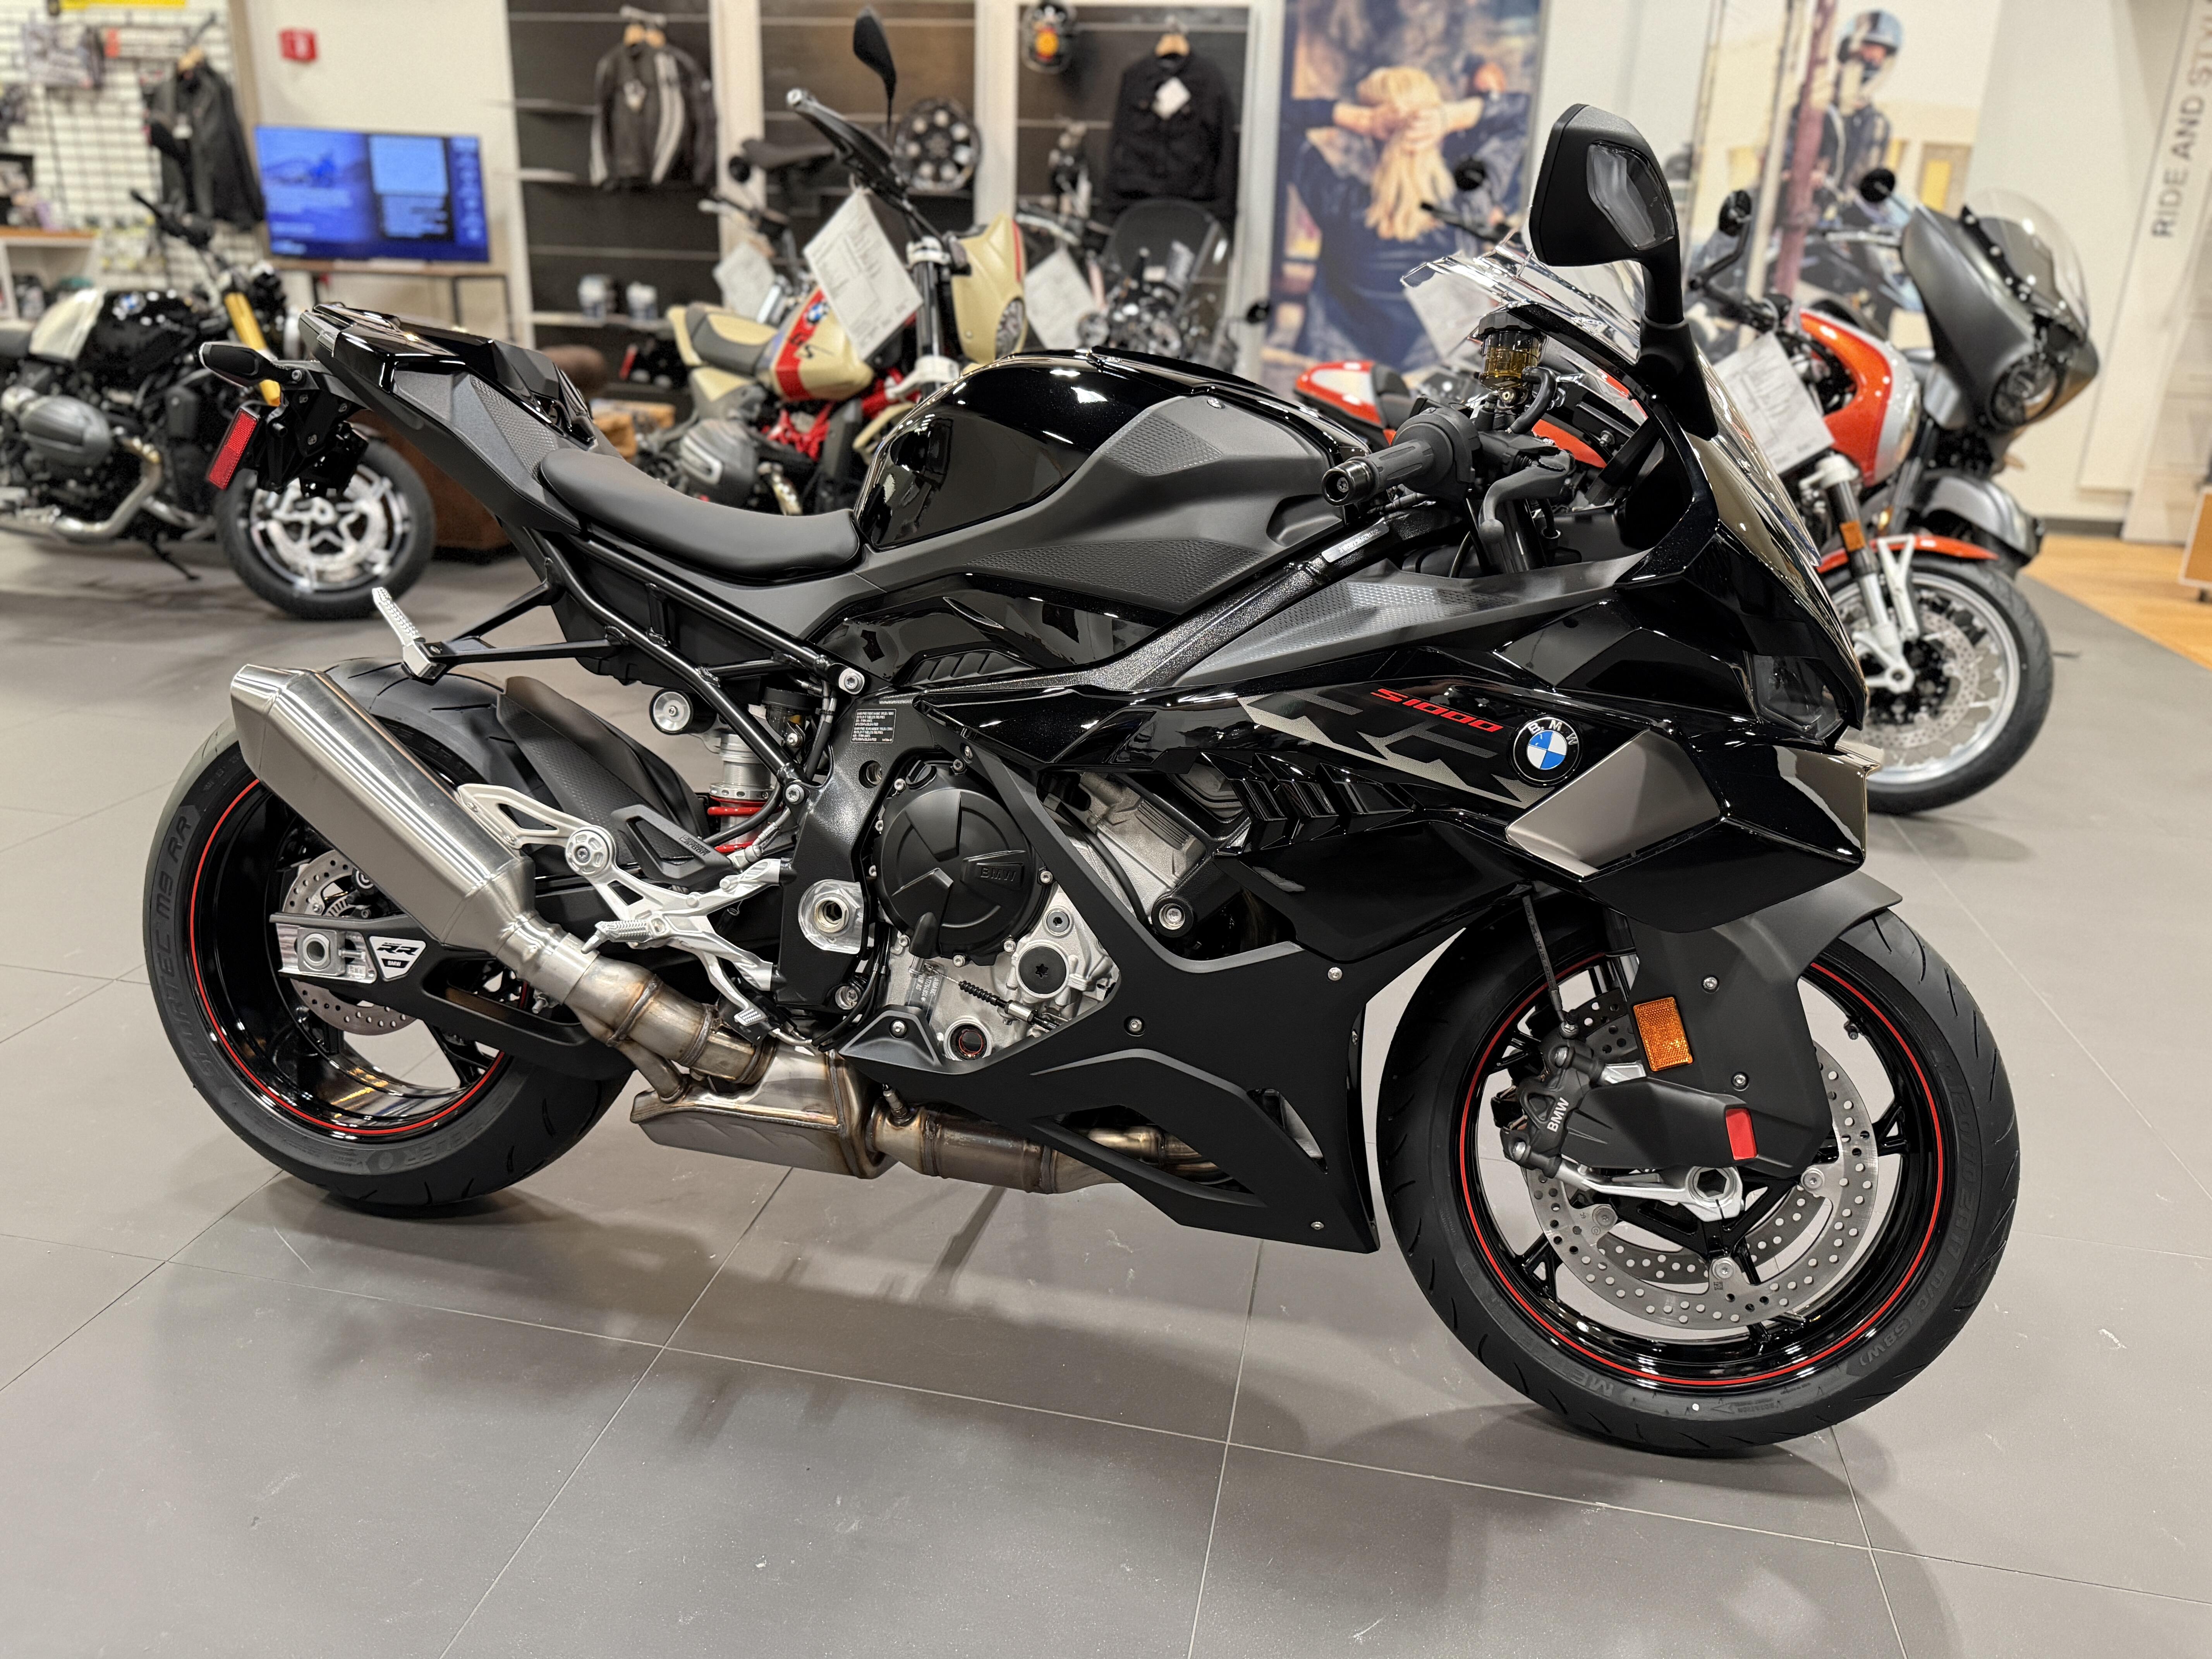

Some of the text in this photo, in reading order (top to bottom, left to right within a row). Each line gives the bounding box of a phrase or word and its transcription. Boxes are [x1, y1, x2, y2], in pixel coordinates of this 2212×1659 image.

[2151, 0, 2212, 238] RIDE AND STY
[1370, 688, 1504, 732] S1000
[1527, 719, 1578, 746] BMW
[156, 871, 173, 920] M9
[168, 816, 191, 864] RR
[980, 867, 1017, 882] BMW
[376, 944, 419, 956] RR
[1547, 1097, 1569, 1132] BMW
[1859, 1314, 1916, 1366] (58W)
